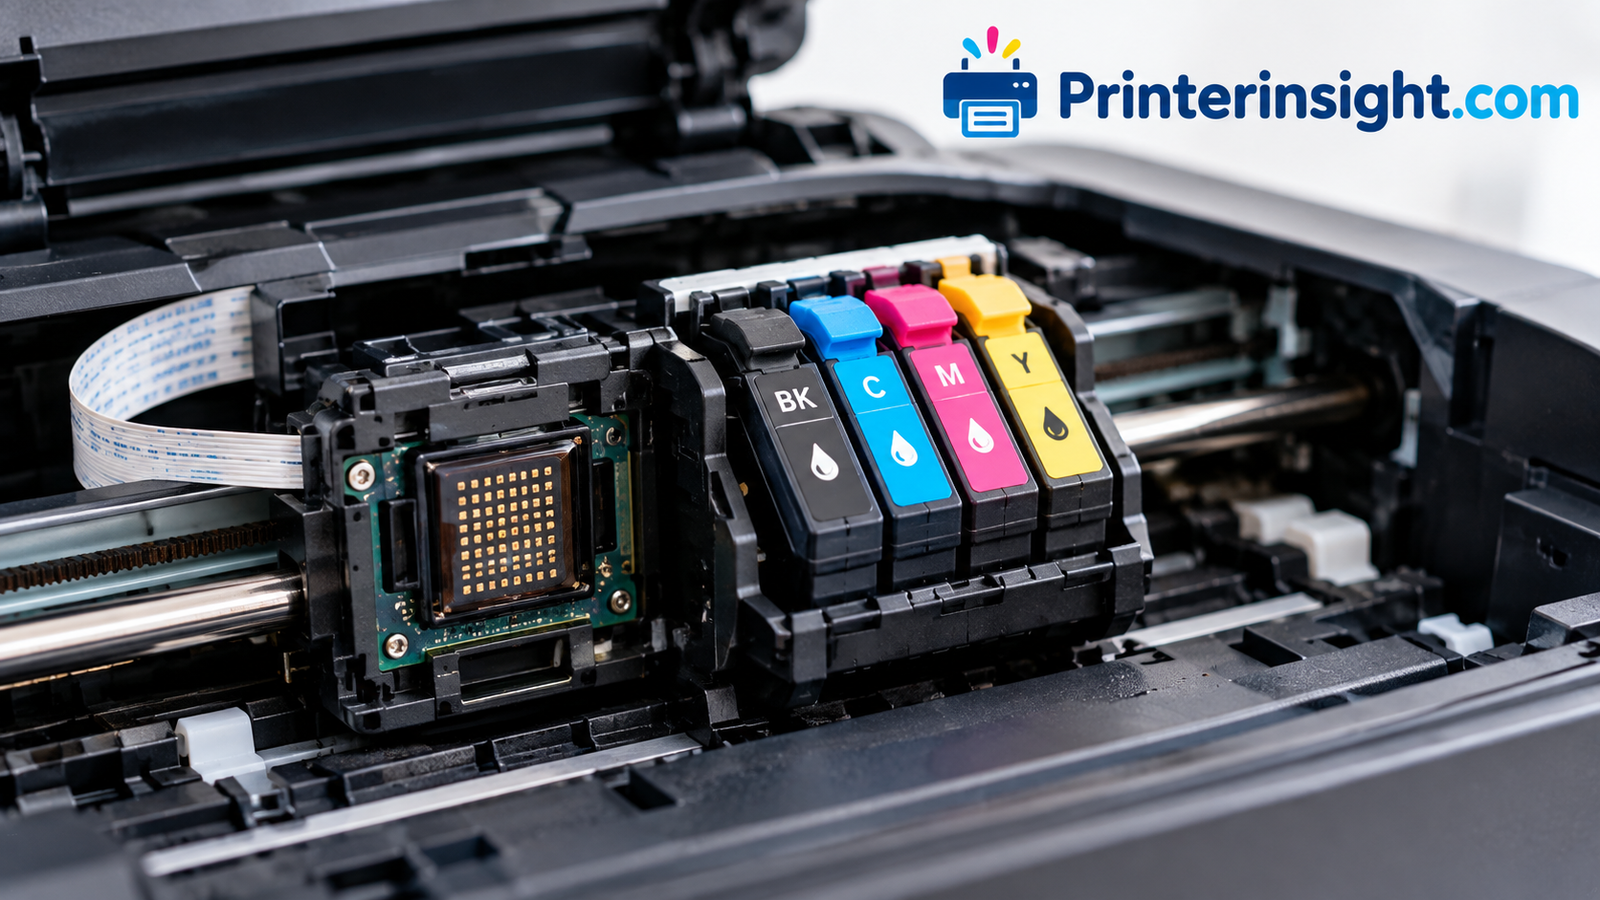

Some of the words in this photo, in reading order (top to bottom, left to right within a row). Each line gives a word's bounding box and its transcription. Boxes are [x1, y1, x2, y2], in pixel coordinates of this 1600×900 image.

[934, 362, 966, 387] M
[1011, 351, 1031, 374] Y
[862, 375, 887, 399] C
[774, 386, 818, 413] BK
